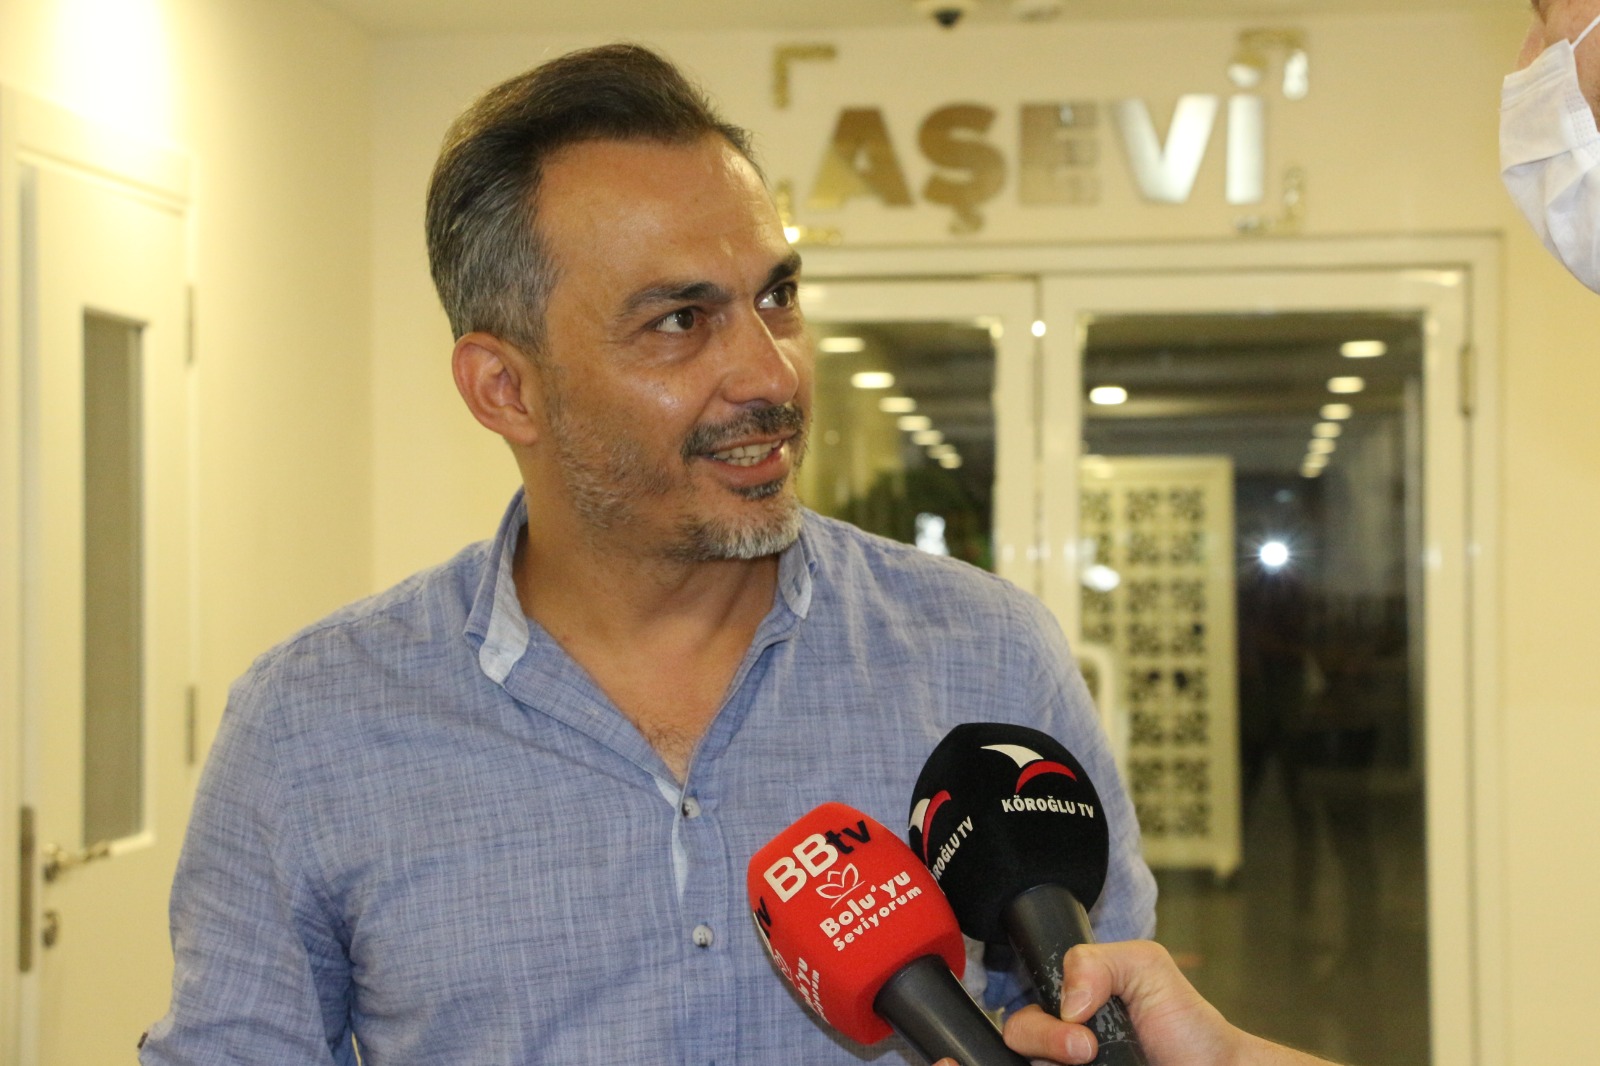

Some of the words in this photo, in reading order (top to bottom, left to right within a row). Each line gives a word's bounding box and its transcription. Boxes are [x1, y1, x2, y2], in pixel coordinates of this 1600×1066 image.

[957, 815, 974, 838] TV
[1001, 794, 1076, 814] KÖROĞLU
[1077, 802, 1094, 818] TV
[819, 871, 911, 938] Bolu'yu
[833, 886, 922, 951] Seviyorum
